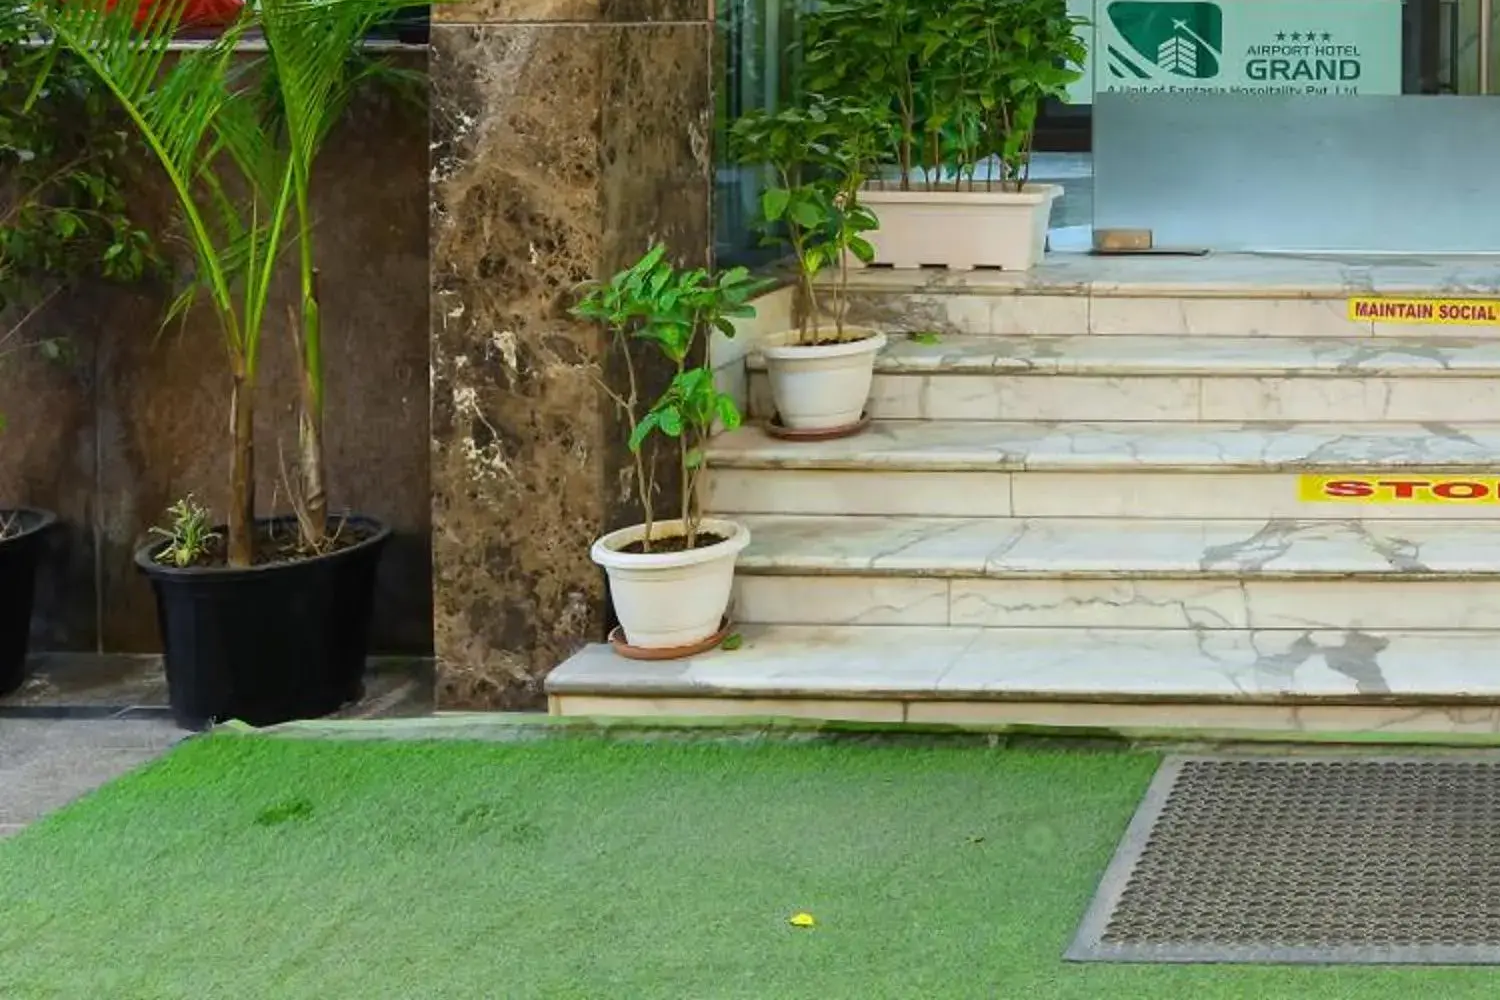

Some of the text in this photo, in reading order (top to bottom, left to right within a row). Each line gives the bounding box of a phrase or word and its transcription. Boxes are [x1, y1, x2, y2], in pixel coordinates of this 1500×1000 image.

[1246, 45, 1361, 57] AIRPORT HOTEL
[1245, 59, 1361, 81] GRAND
[1354, 302, 1433, 319] MAINTAIN
[1438, 304, 1497, 321] SOCIAL
